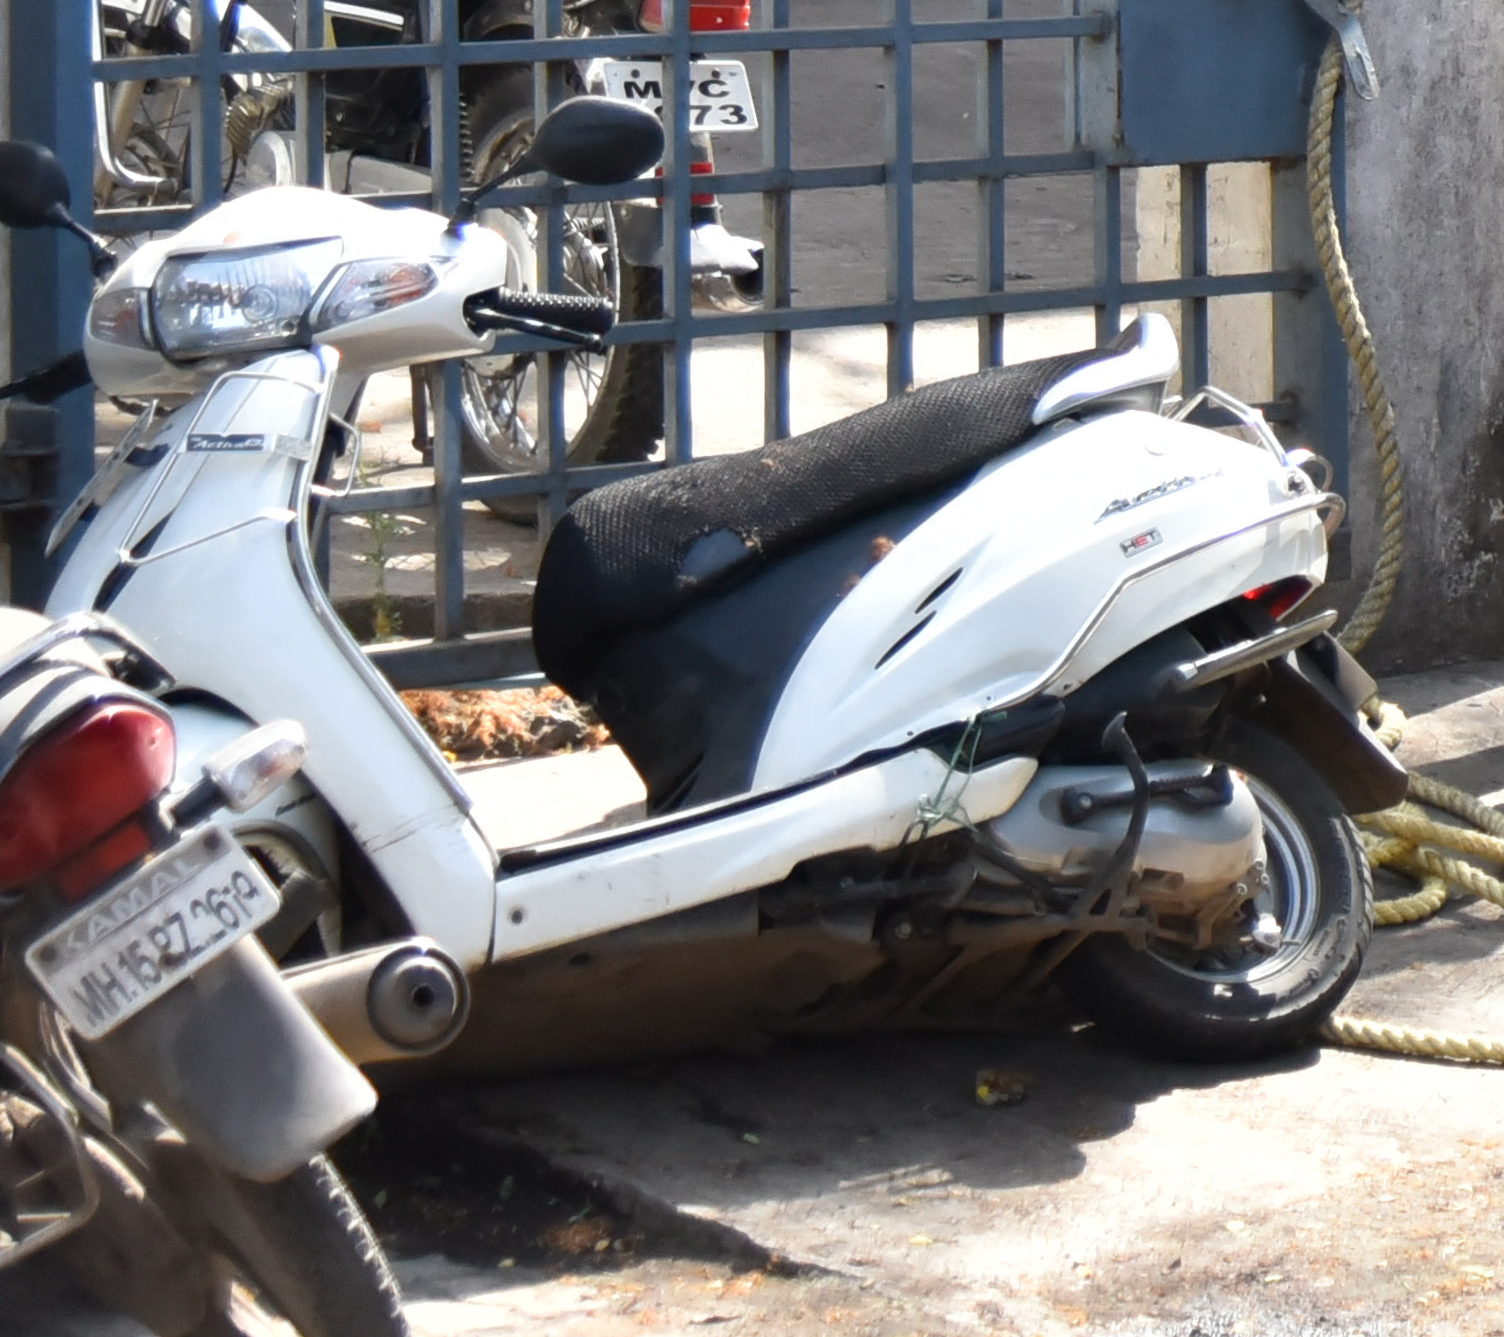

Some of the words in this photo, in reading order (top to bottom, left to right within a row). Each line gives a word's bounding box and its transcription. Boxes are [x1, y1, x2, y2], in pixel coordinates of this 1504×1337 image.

[624, 79, 731, 98] MC
[1121, 530, 1157, 553] HET
[64, 859, 193, 958] KAMAL
